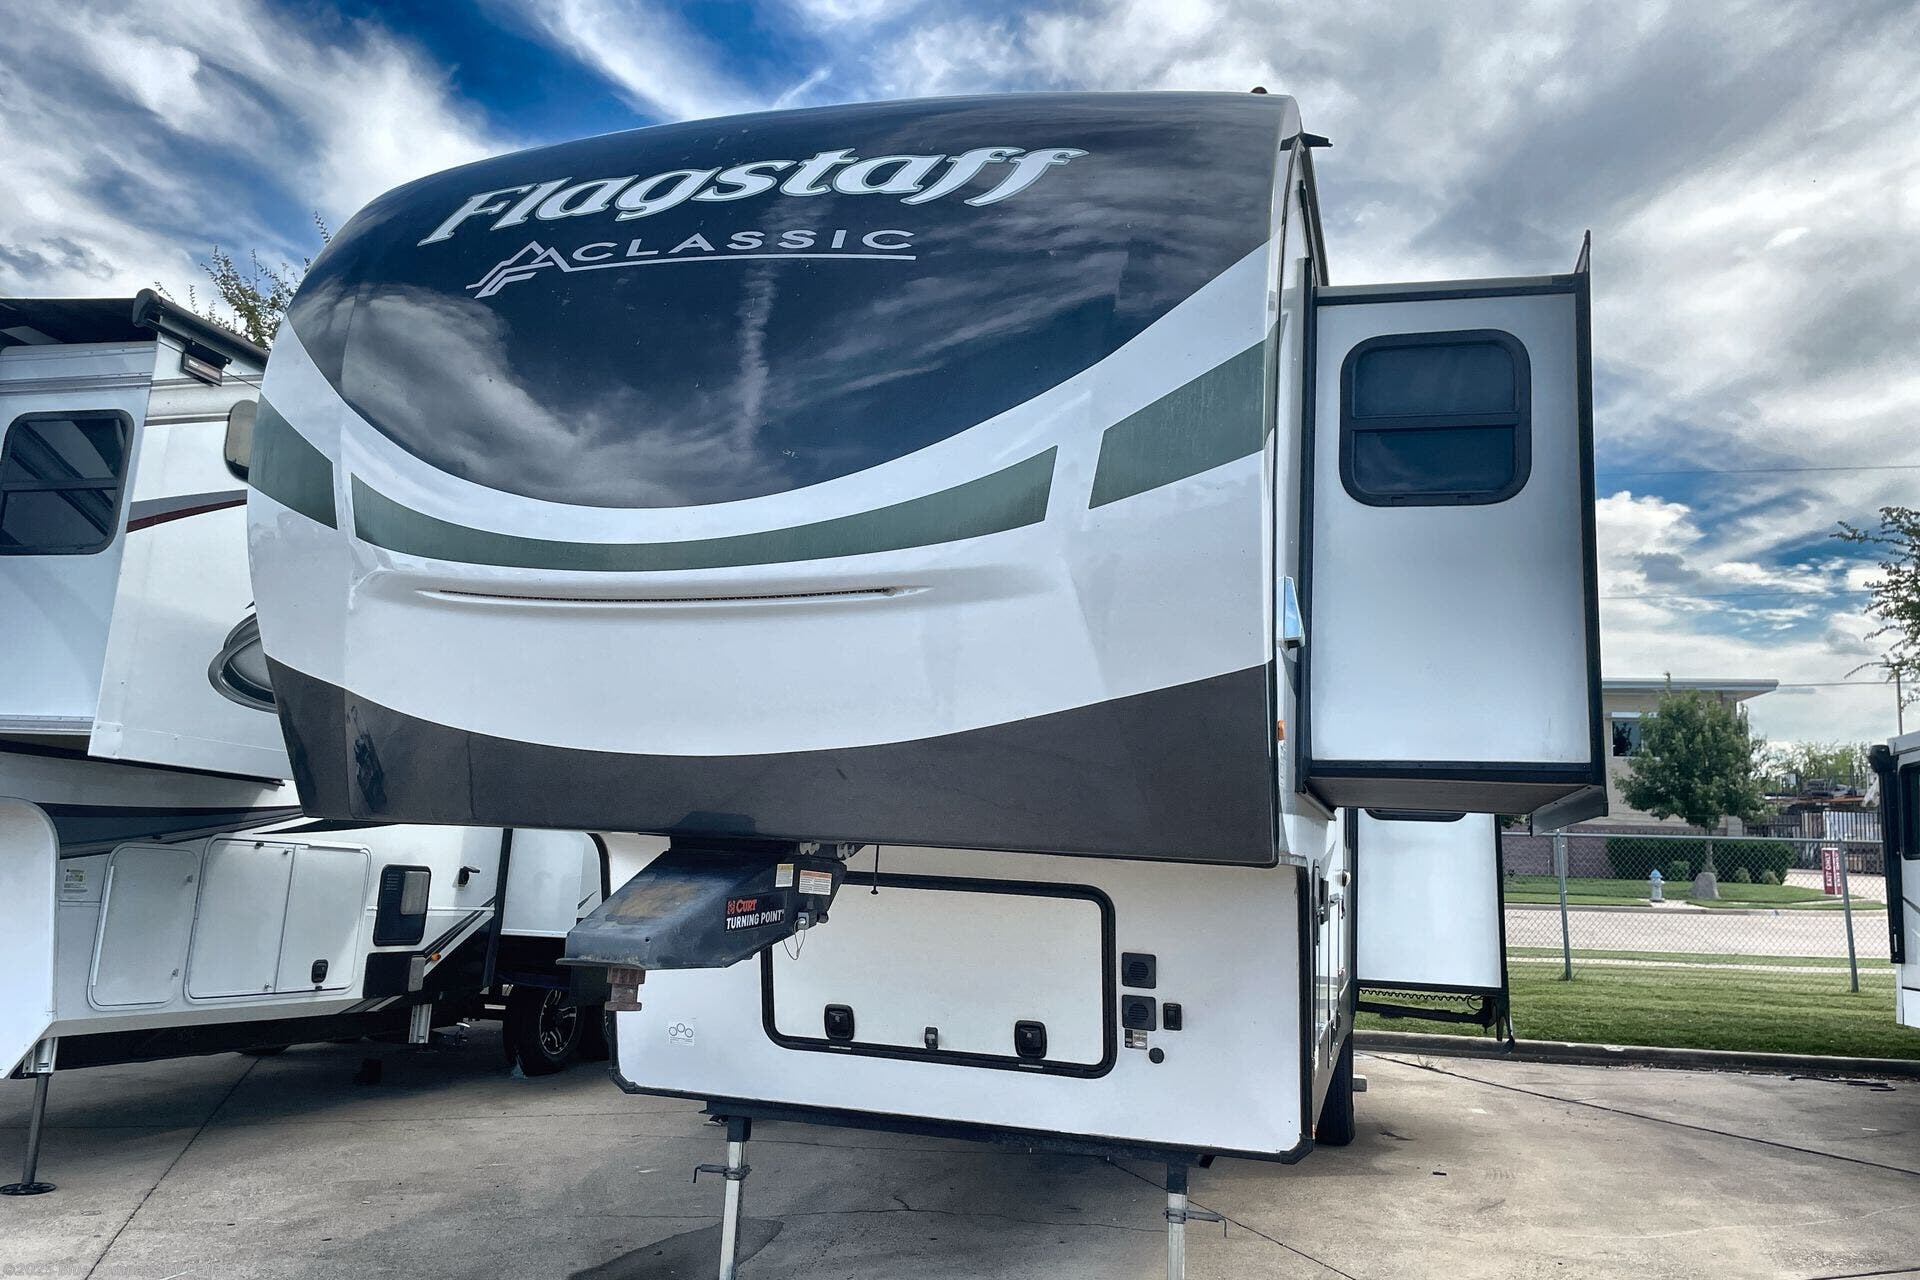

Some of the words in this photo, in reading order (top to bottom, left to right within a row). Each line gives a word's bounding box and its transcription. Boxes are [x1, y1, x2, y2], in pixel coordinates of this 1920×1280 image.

[417, 146, 1090, 246] Flagstaff
[571, 229, 916, 262] CLASSIC
[736, 899, 757, 913] CURT
[726, 913, 760, 930] TURNING
